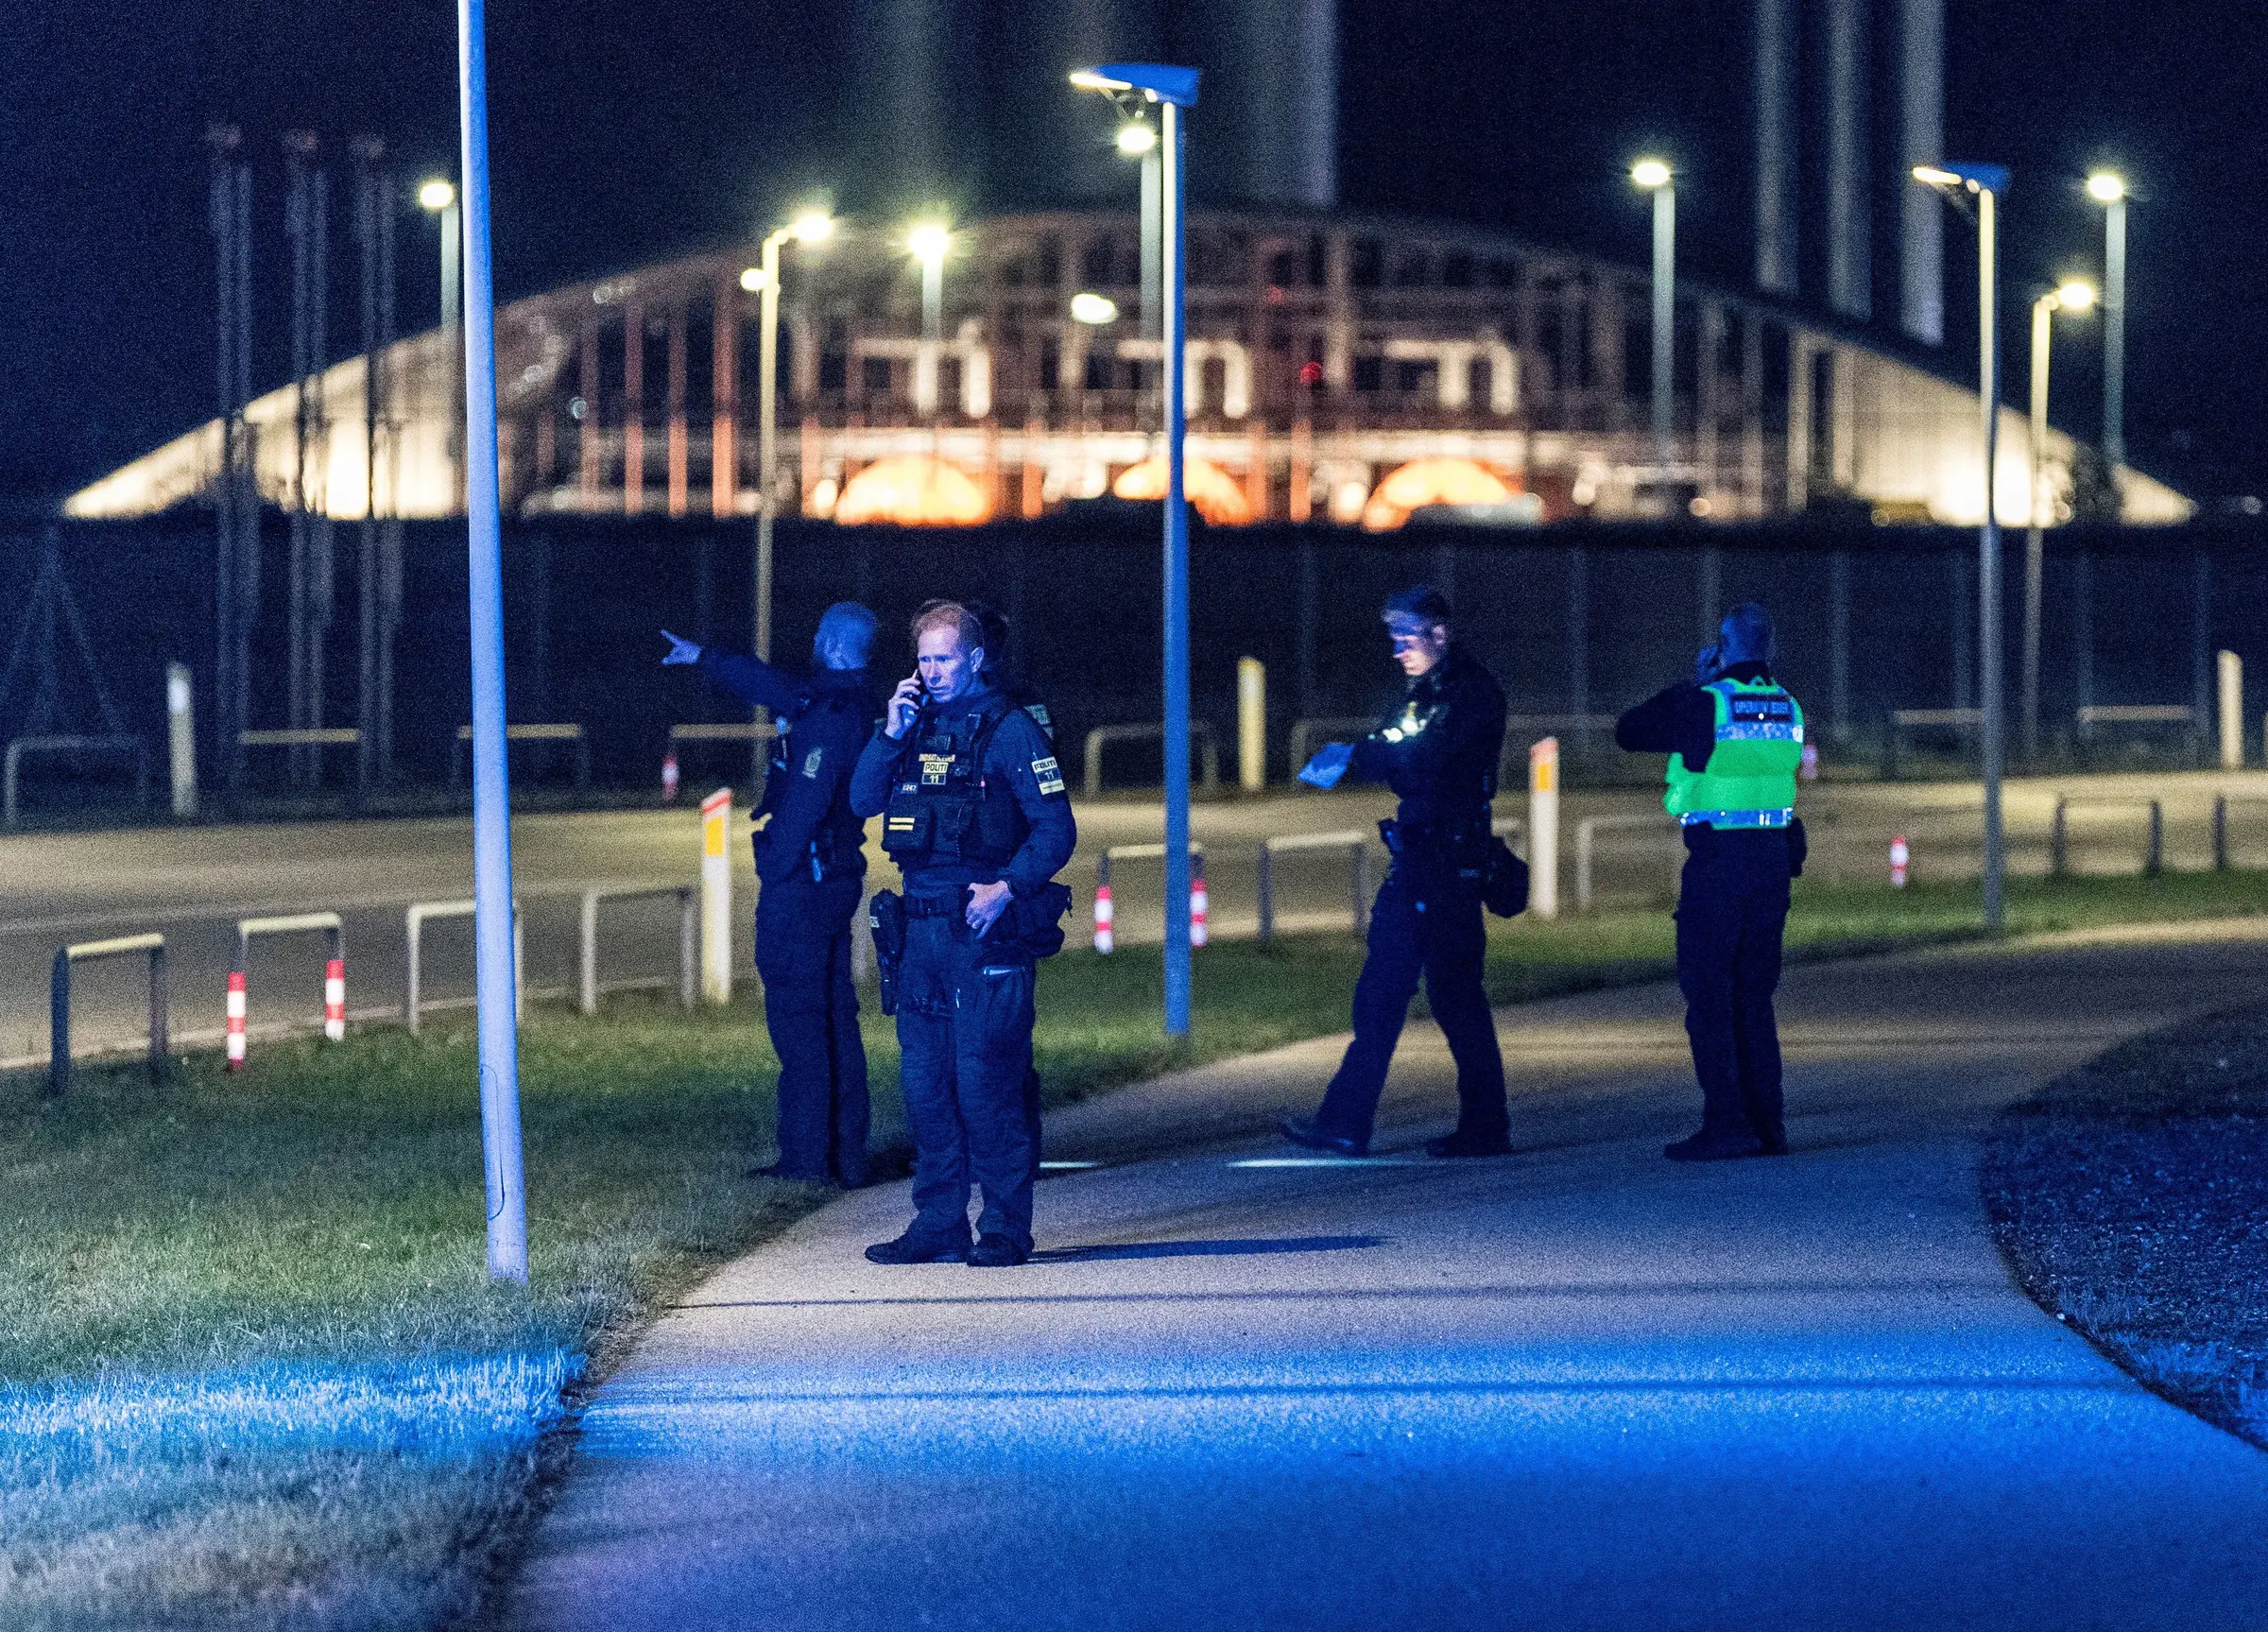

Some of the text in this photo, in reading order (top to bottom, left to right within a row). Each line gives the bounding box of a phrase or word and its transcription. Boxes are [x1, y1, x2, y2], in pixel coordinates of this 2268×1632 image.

[925, 763, 948, 772] POLITI
[1034, 760, 1057, 771] POLITI
[929, 775, 939, 784] 11
[1043, 771, 1055, 780] 11
